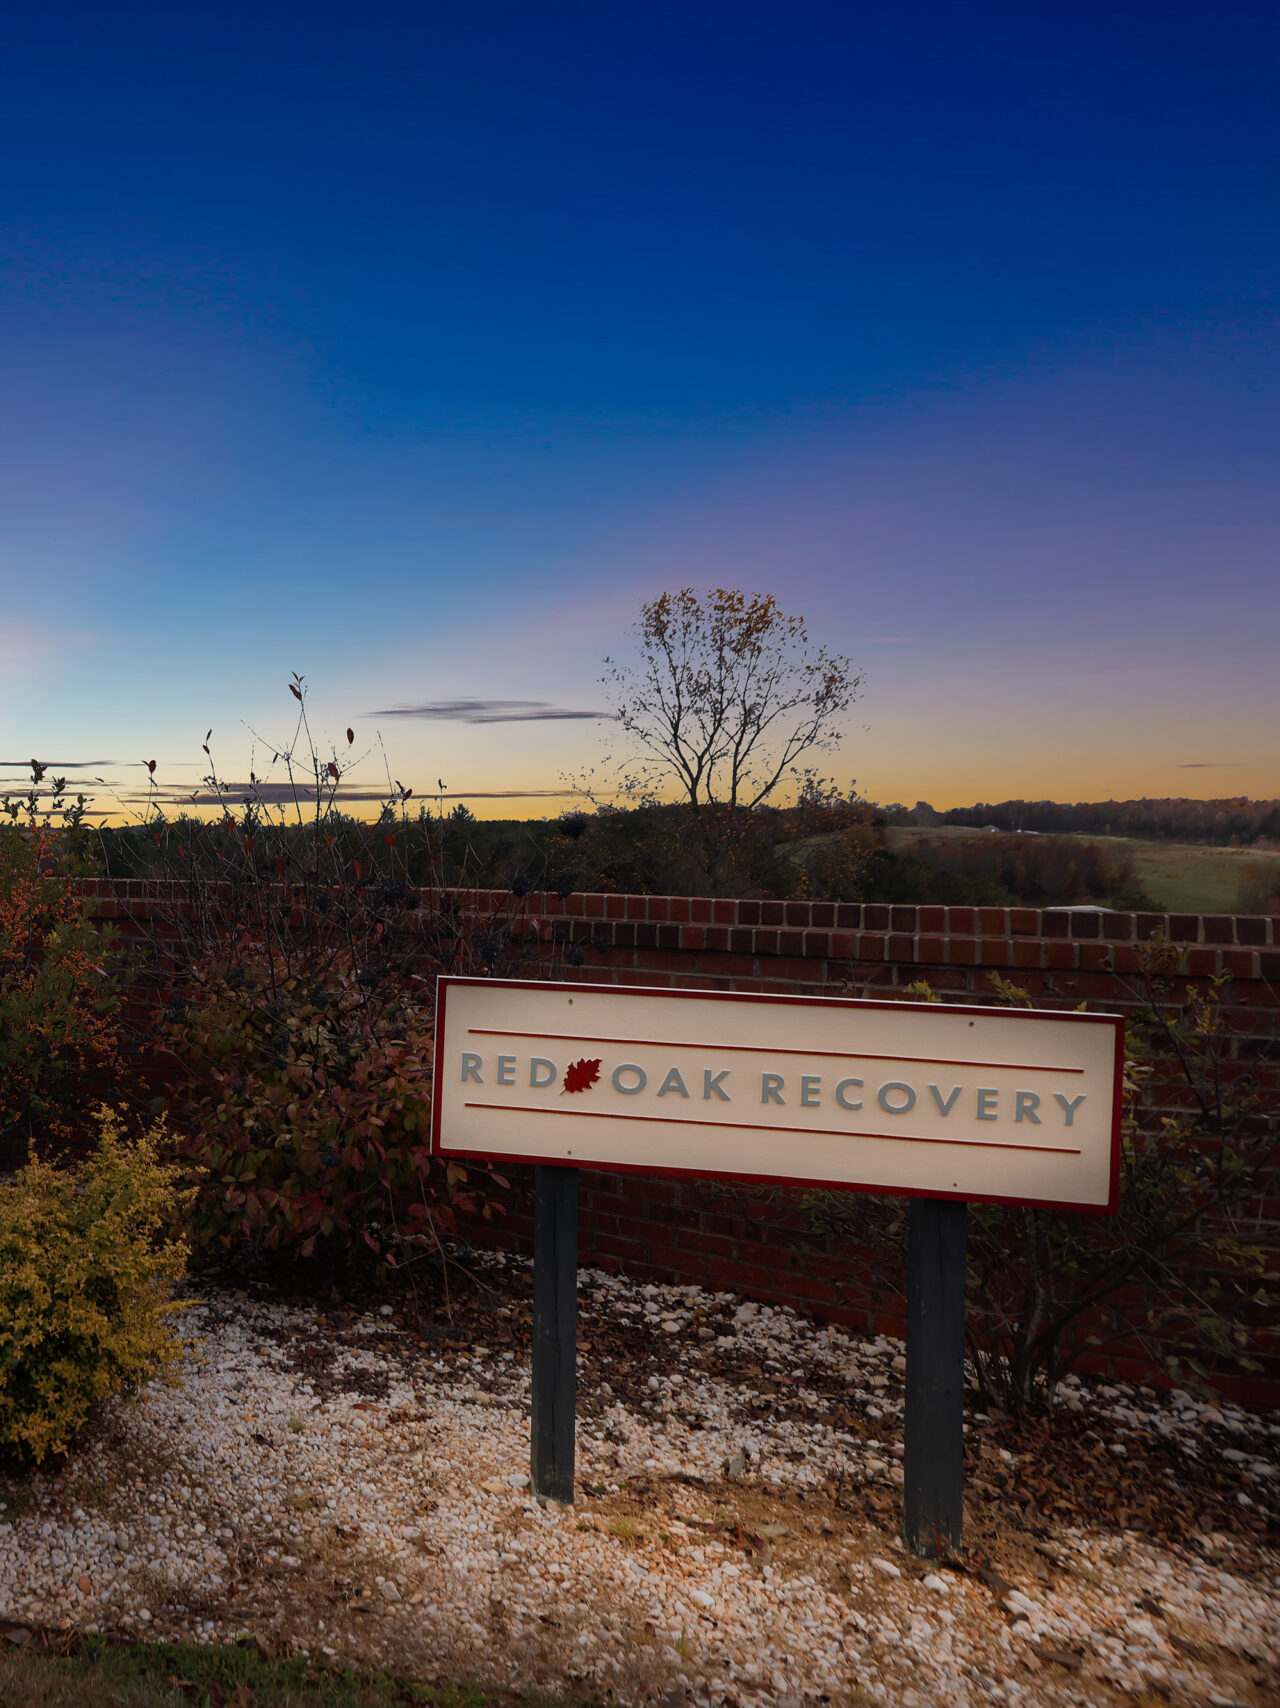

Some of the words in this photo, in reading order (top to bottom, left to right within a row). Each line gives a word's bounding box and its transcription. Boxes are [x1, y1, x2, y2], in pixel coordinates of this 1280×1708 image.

[461, 1052, 557, 1088] RED
[612, 1063, 732, 1101] OAK
[761, 1072, 1087, 1126] RECOVERY
